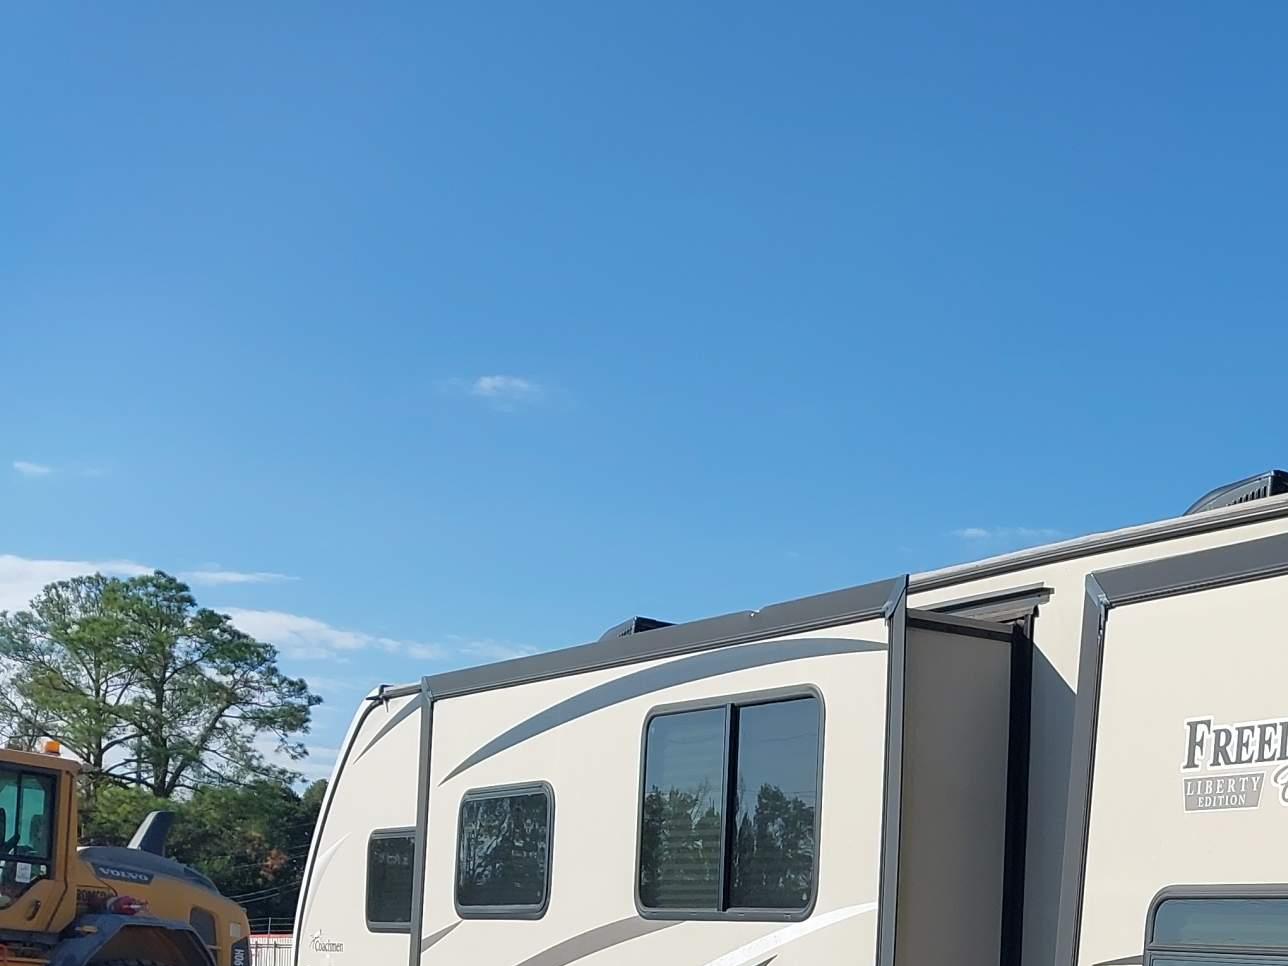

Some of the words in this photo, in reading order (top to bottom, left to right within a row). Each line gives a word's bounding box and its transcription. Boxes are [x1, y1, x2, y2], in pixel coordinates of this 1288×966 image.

[1186, 776, 1261, 796] LIBERTY
[1197, 793, 1246, 808] EDITION
[98, 866, 150, 881] VOLVO
[314, 939, 344, 952] Coachmen
